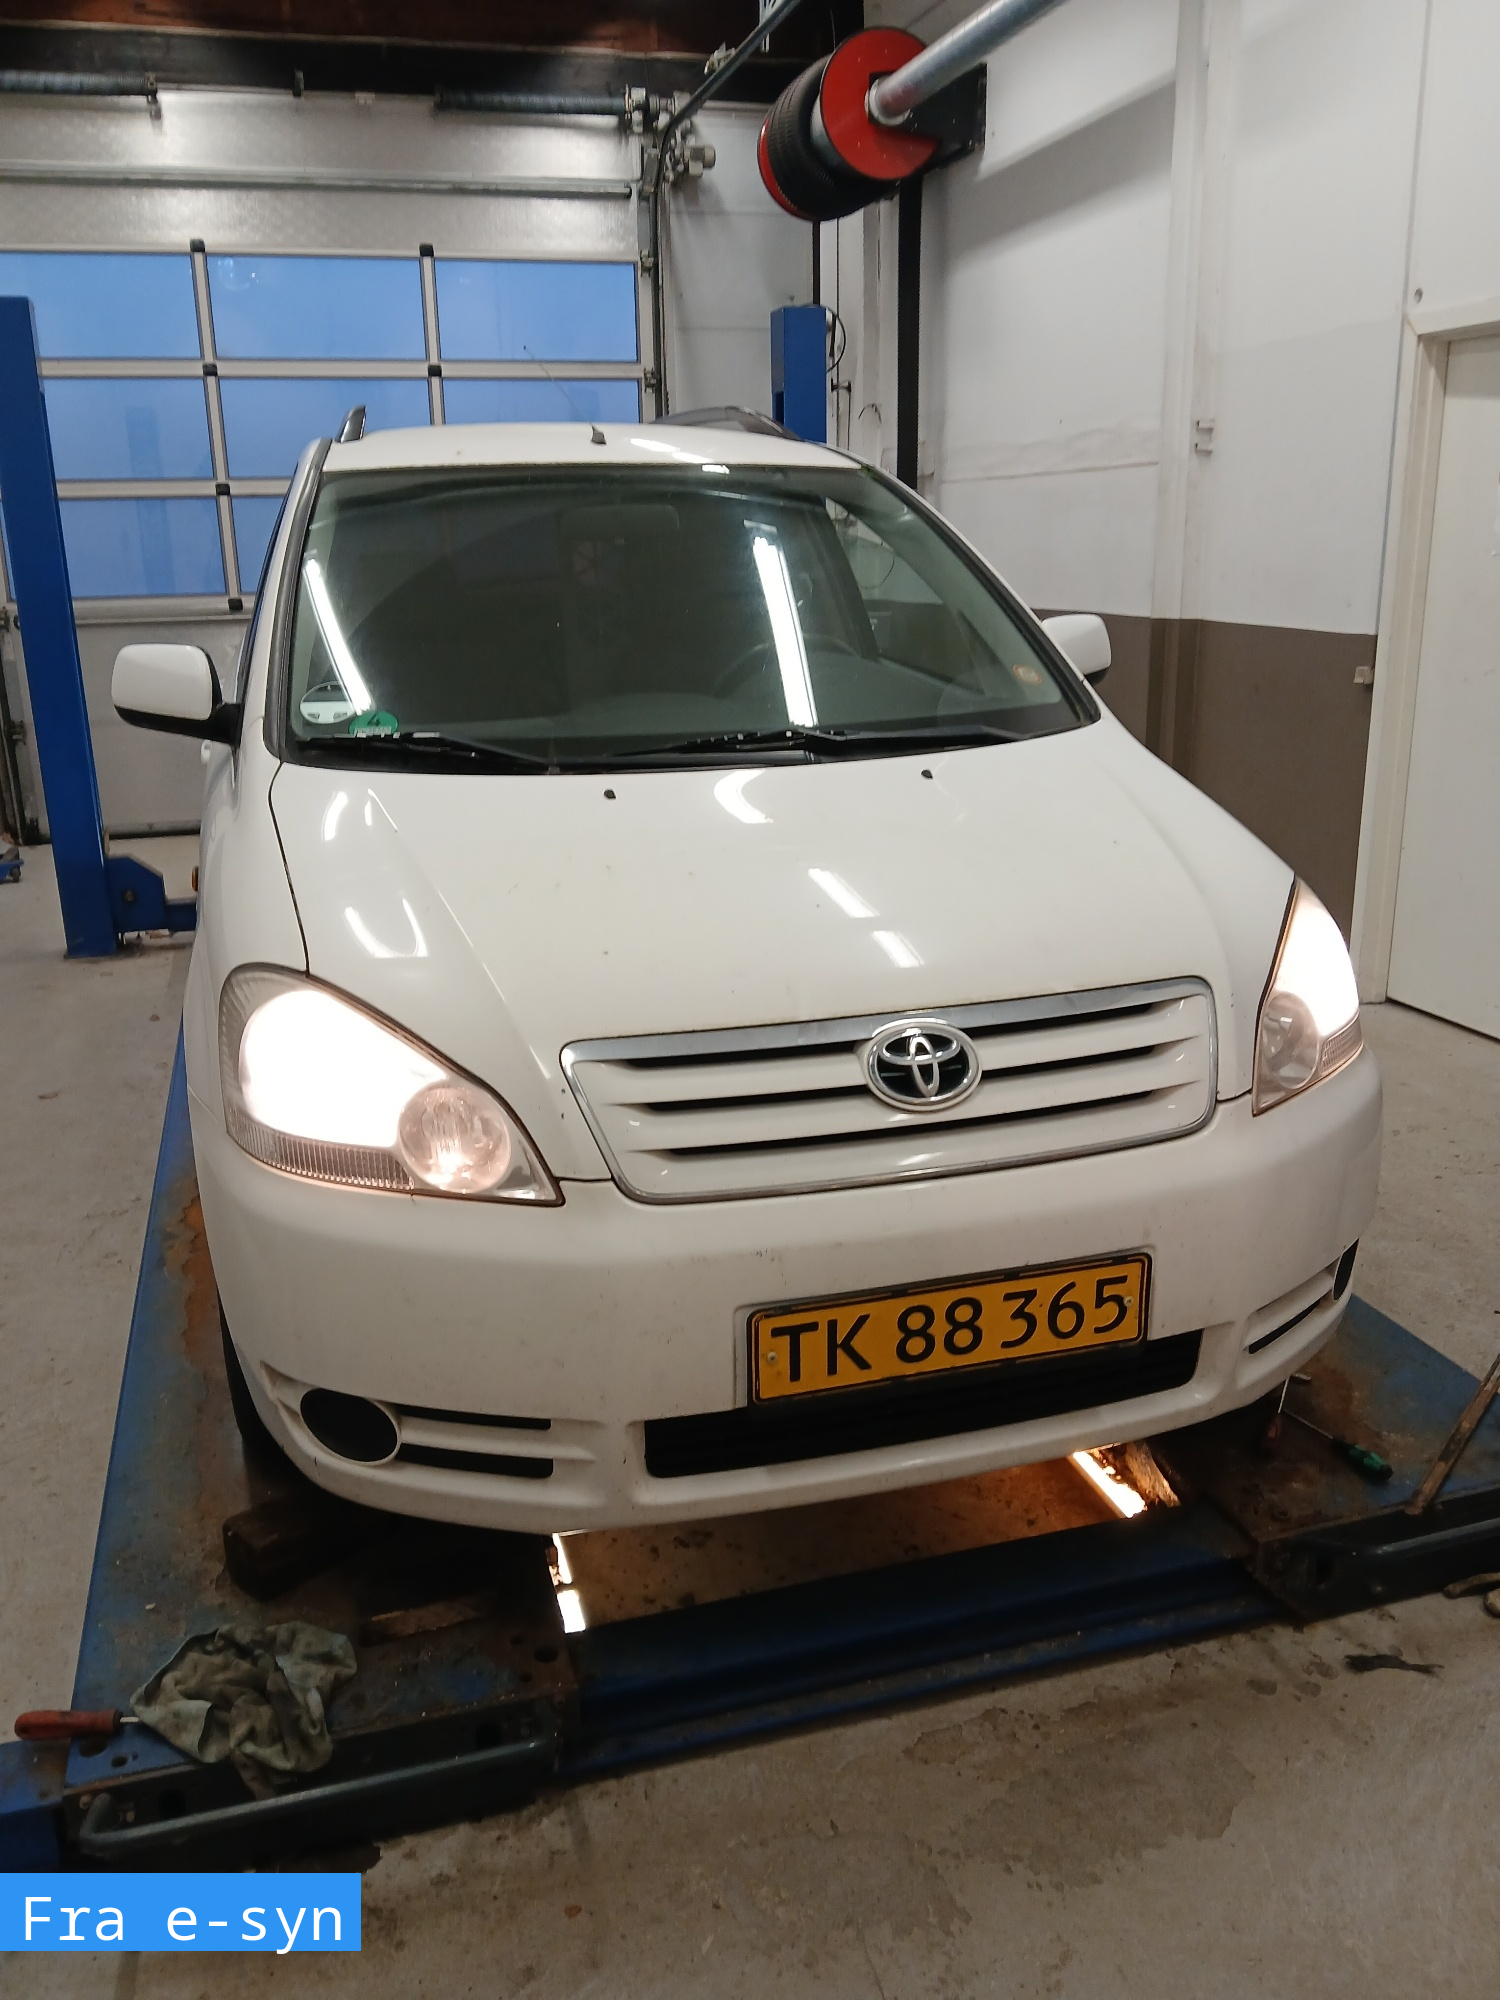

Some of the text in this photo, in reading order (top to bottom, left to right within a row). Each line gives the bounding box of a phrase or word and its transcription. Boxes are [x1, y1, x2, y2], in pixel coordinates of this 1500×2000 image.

[770, 1275, 1130, 1384] TK 88 365
